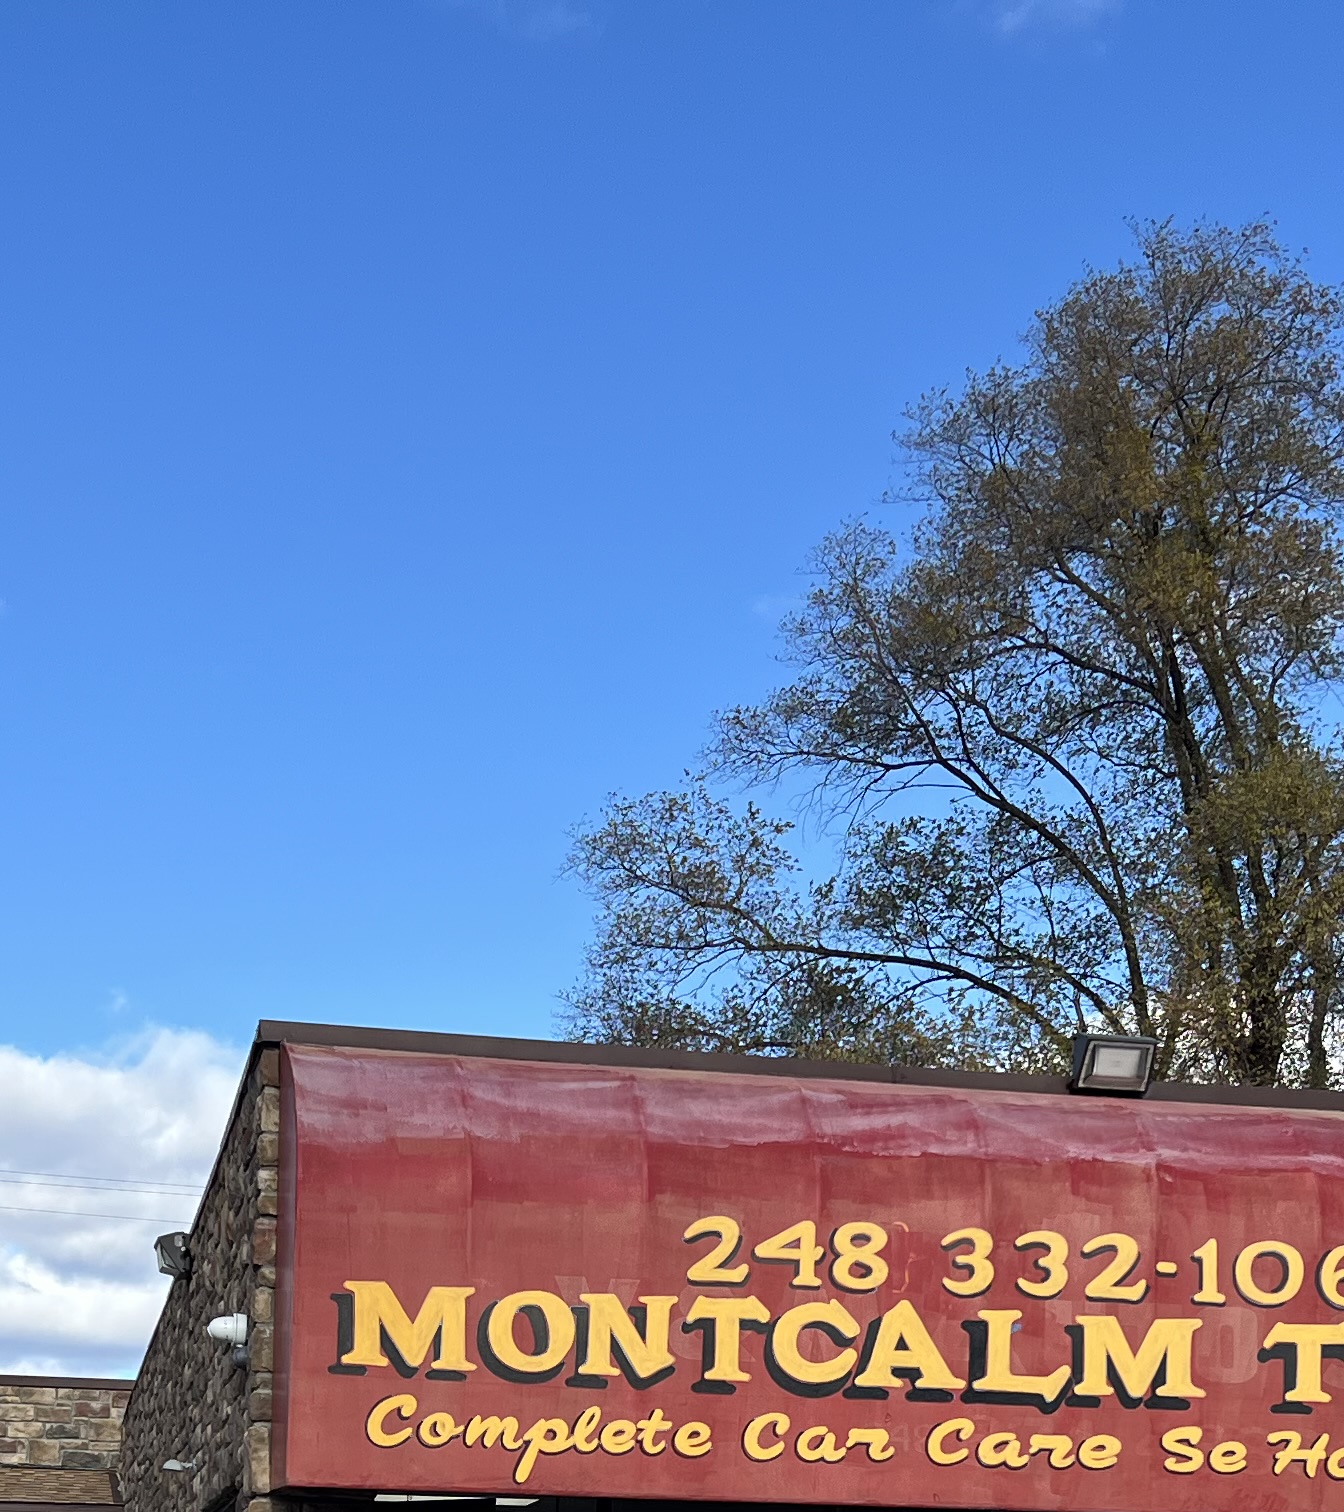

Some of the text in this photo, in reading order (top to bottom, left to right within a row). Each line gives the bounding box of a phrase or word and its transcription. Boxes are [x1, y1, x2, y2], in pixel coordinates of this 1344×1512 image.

[683, 1215, 889, 1292] 248
[330, 1280, 1205, 1412] MONTCALM
[365, 1394, 713, 1483] Complete
[743, 1412, 896, 1466] Car
[927, 1416, 1122, 1473] Care
[1162, 1425, 1247, 1476] Se
